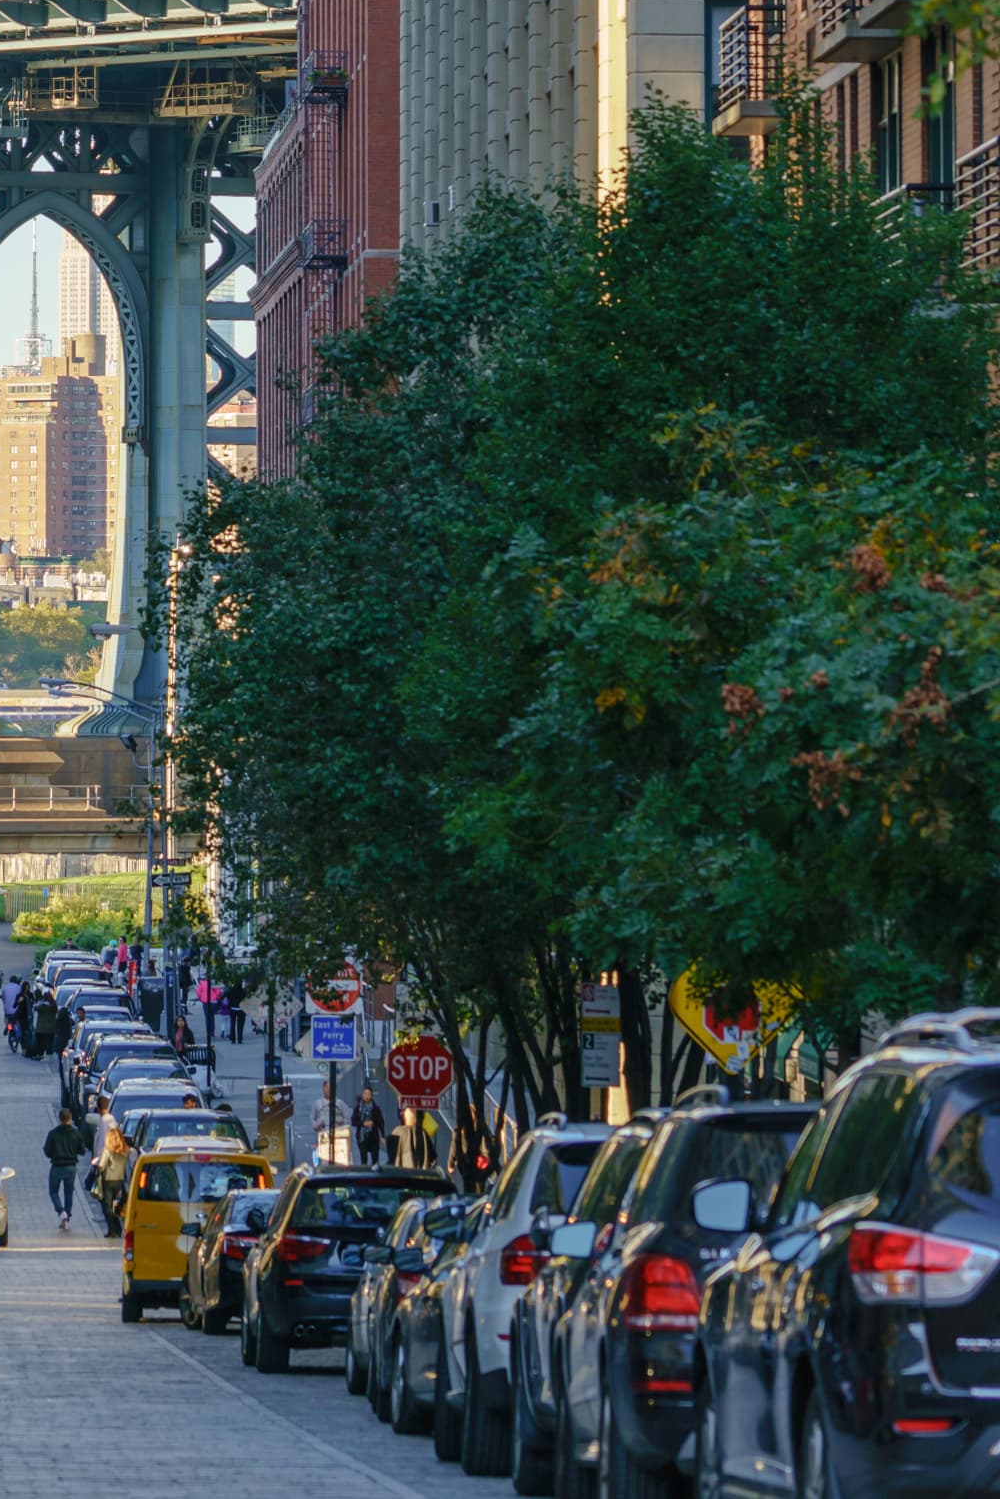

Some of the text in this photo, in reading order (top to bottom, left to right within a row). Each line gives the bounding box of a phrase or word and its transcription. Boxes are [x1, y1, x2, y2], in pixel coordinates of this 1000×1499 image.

[323, 1032, 344, 1041] Ferry
[392, 1055, 449, 1080] STOP
[421, 1099, 436, 1107] WAY
